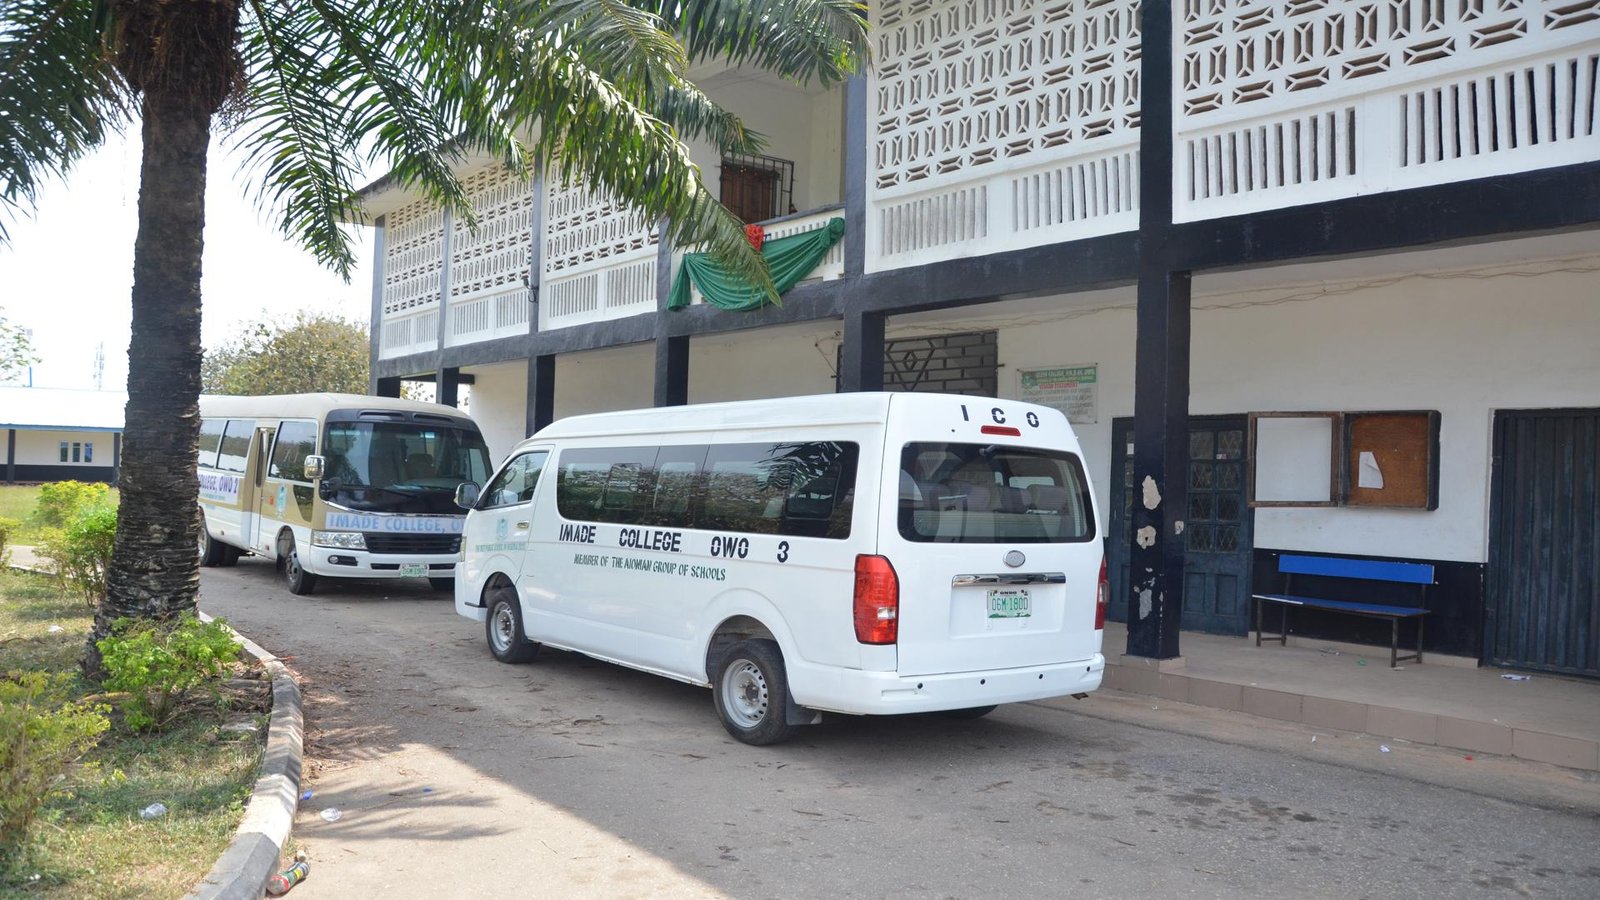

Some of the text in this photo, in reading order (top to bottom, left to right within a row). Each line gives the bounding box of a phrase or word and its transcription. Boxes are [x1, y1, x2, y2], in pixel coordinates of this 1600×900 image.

[960, 404, 1040, 428] I C O
[329, 513, 379, 529] IMADE
[384, 516, 446, 533] COLLEGE,
[559, 523, 597, 544] IMADE
[710, 536, 749, 559] OWO
[776, 540, 790, 563] 3
[574, 553, 599, 566] MEMBER
[600, 555, 609, 568] OF
[611, 556, 623, 569] THE
[652, 560, 677, 575] GROUP
[678, 563, 689, 577] OF
[690, 564, 726, 582] SCHOOLS
